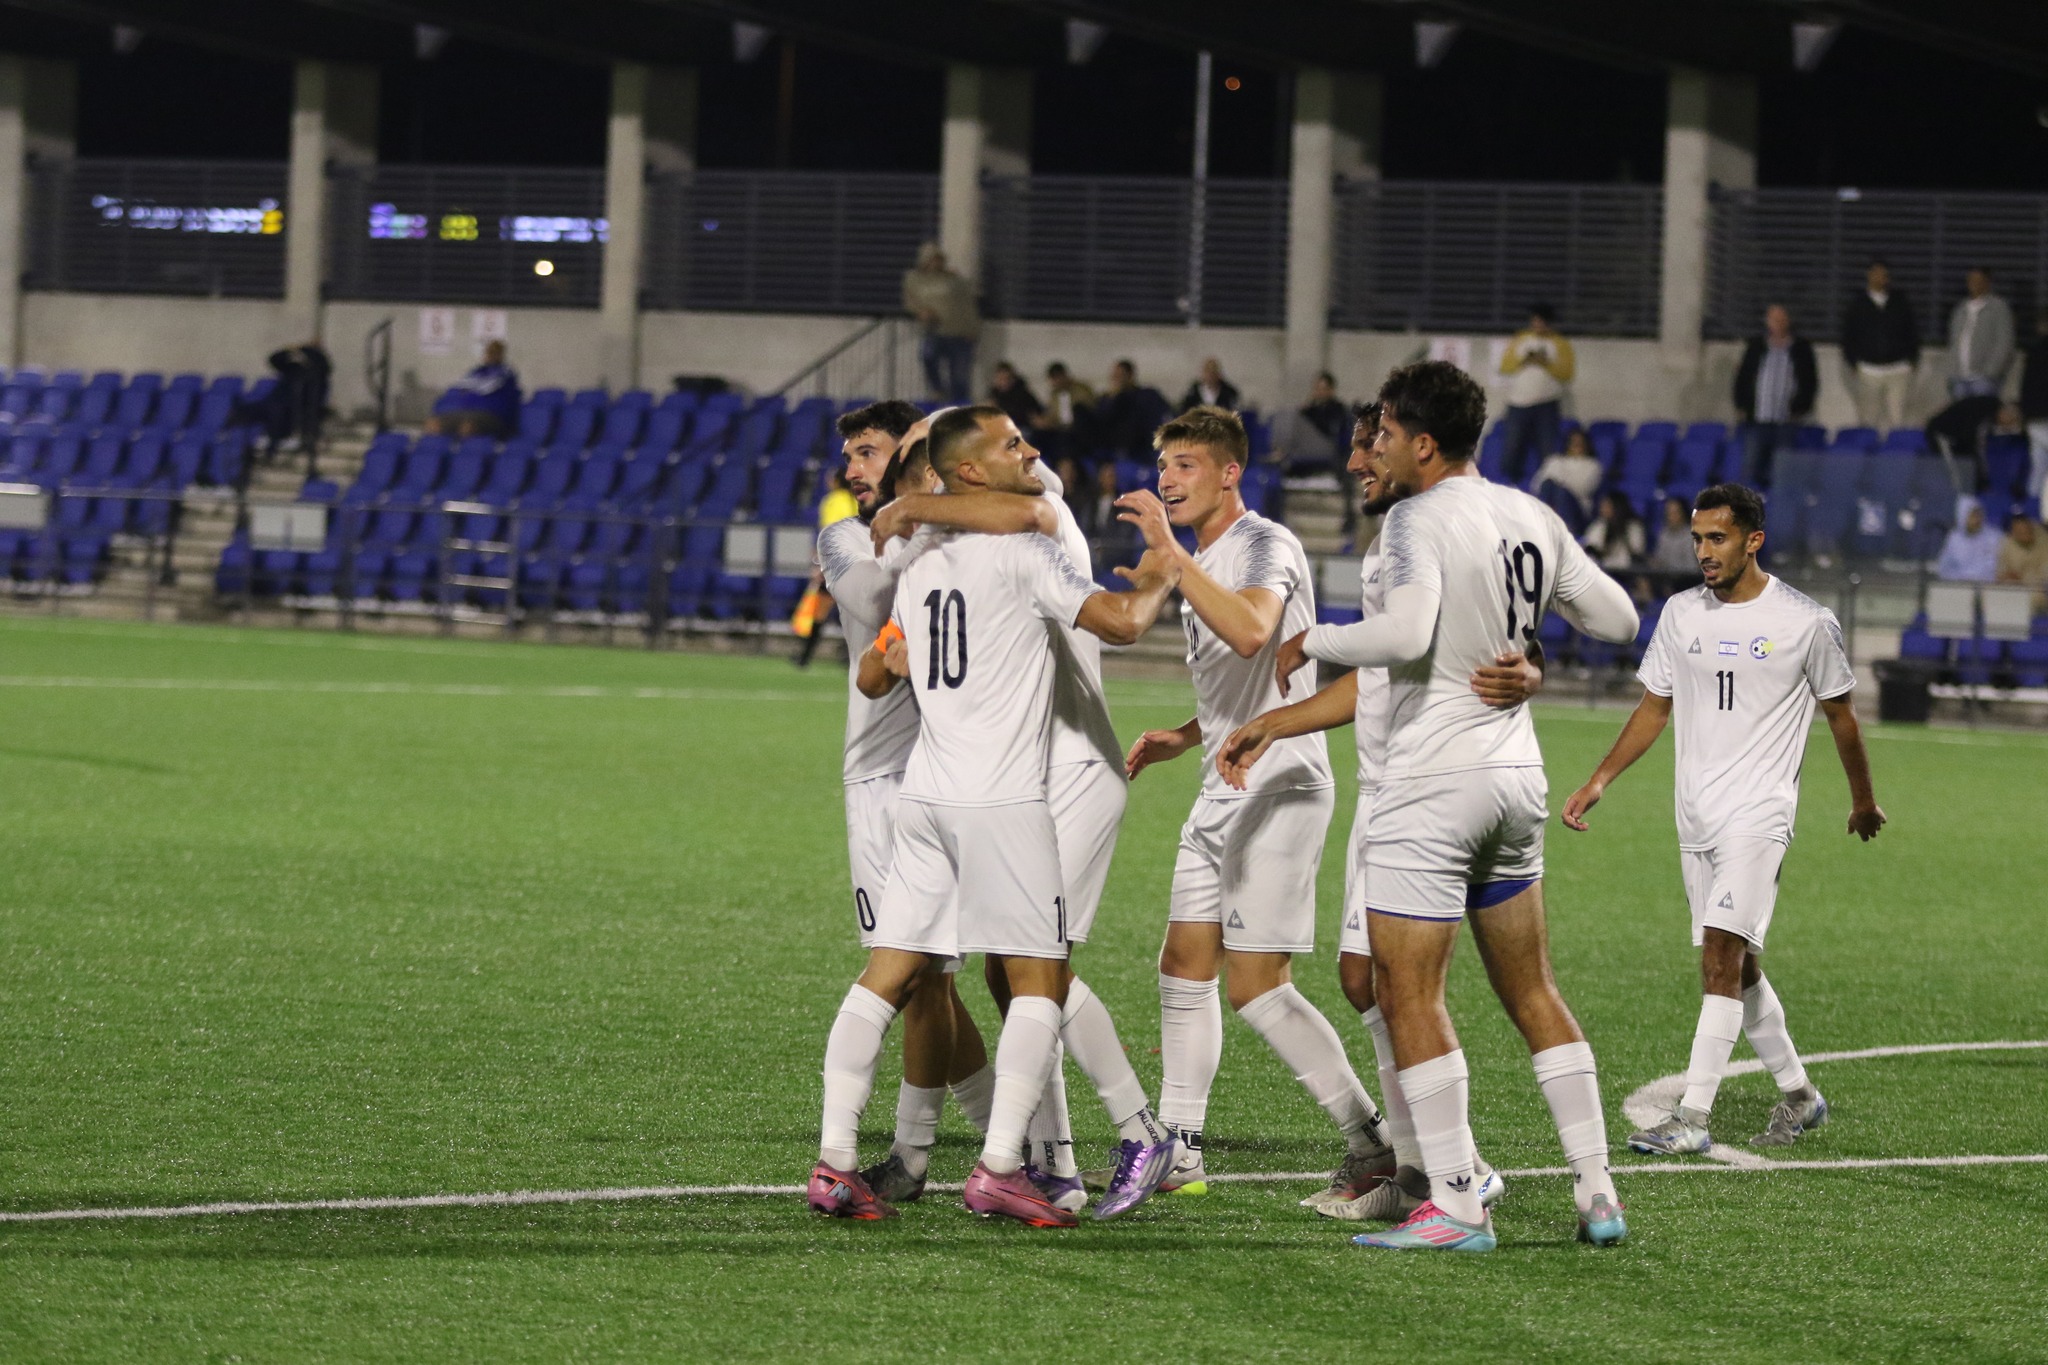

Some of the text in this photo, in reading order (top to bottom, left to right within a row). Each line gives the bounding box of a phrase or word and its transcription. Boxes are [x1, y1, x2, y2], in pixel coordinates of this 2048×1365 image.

[1498, 538, 1544, 642] 19
[923, 588, 968, 691] 10
[1715, 670, 1734, 711] 11
[1053, 895, 1067, 943] 1
